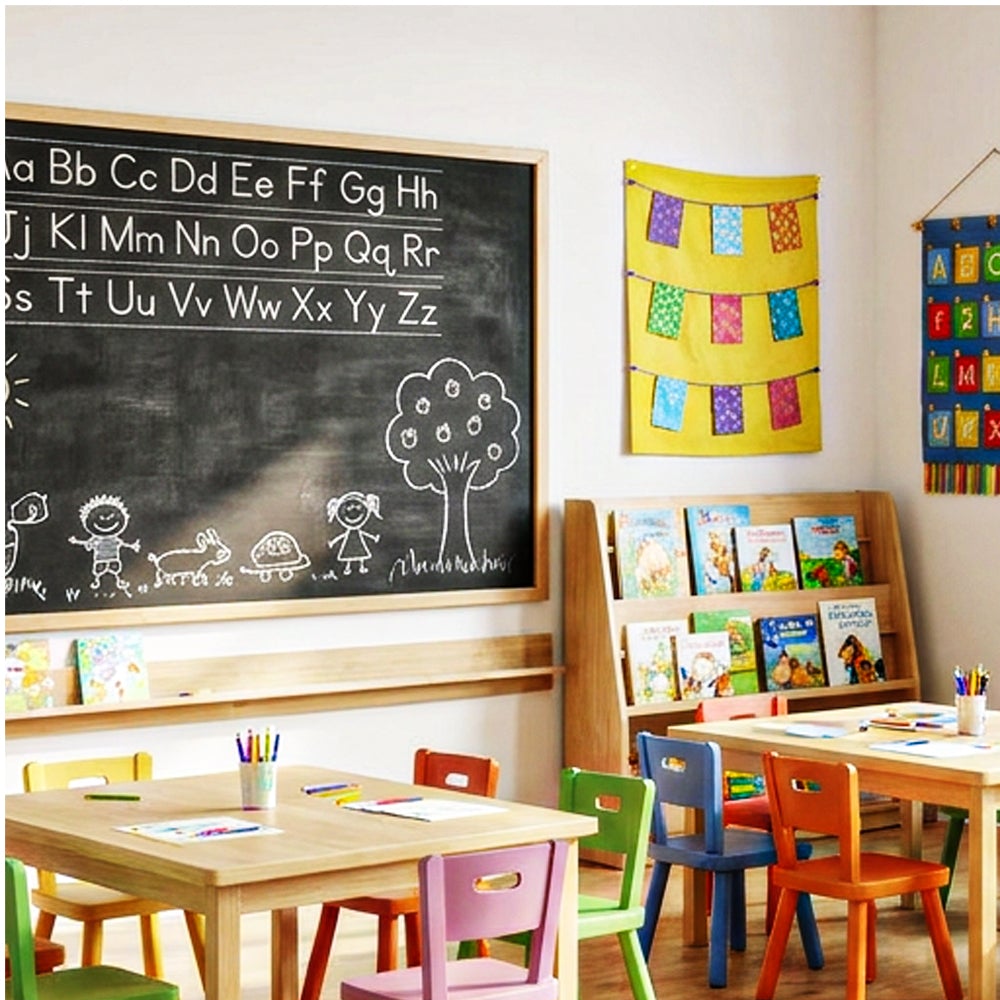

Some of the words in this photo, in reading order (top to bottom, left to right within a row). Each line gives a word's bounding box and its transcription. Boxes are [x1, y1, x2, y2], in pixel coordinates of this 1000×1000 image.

[5, 159, 34, 182] a
[49, 147, 97, 187] Bb
[110, 153, 158, 191] Cc
[171, 157, 217, 195] Dd
[231, 161, 274, 199] Ee
[287, 165, 328, 202] Ff
[340, 170, 386, 217] Gg
[397, 173, 438, 210] Hh
[101, 215, 164, 254] Mm
[175, 219, 220, 257] Nn
[231, 223, 280, 260] Oo
[291, 226, 334, 273] Pp
[344, 229, 397, 277] Qq
[403, 233, 441, 268] Rr
[932, 253, 948, 279] A
[47, 276, 94, 315] Tt
[107, 278, 156, 317] Uu
[167, 281, 213, 318] Vv
[223, 283, 283, 321] Ww
[291, 286, 333, 322] Xx
[343, 288, 386, 334] Yy
[397, 291, 439, 326] Zz
[932, 364, 946, 387] L
